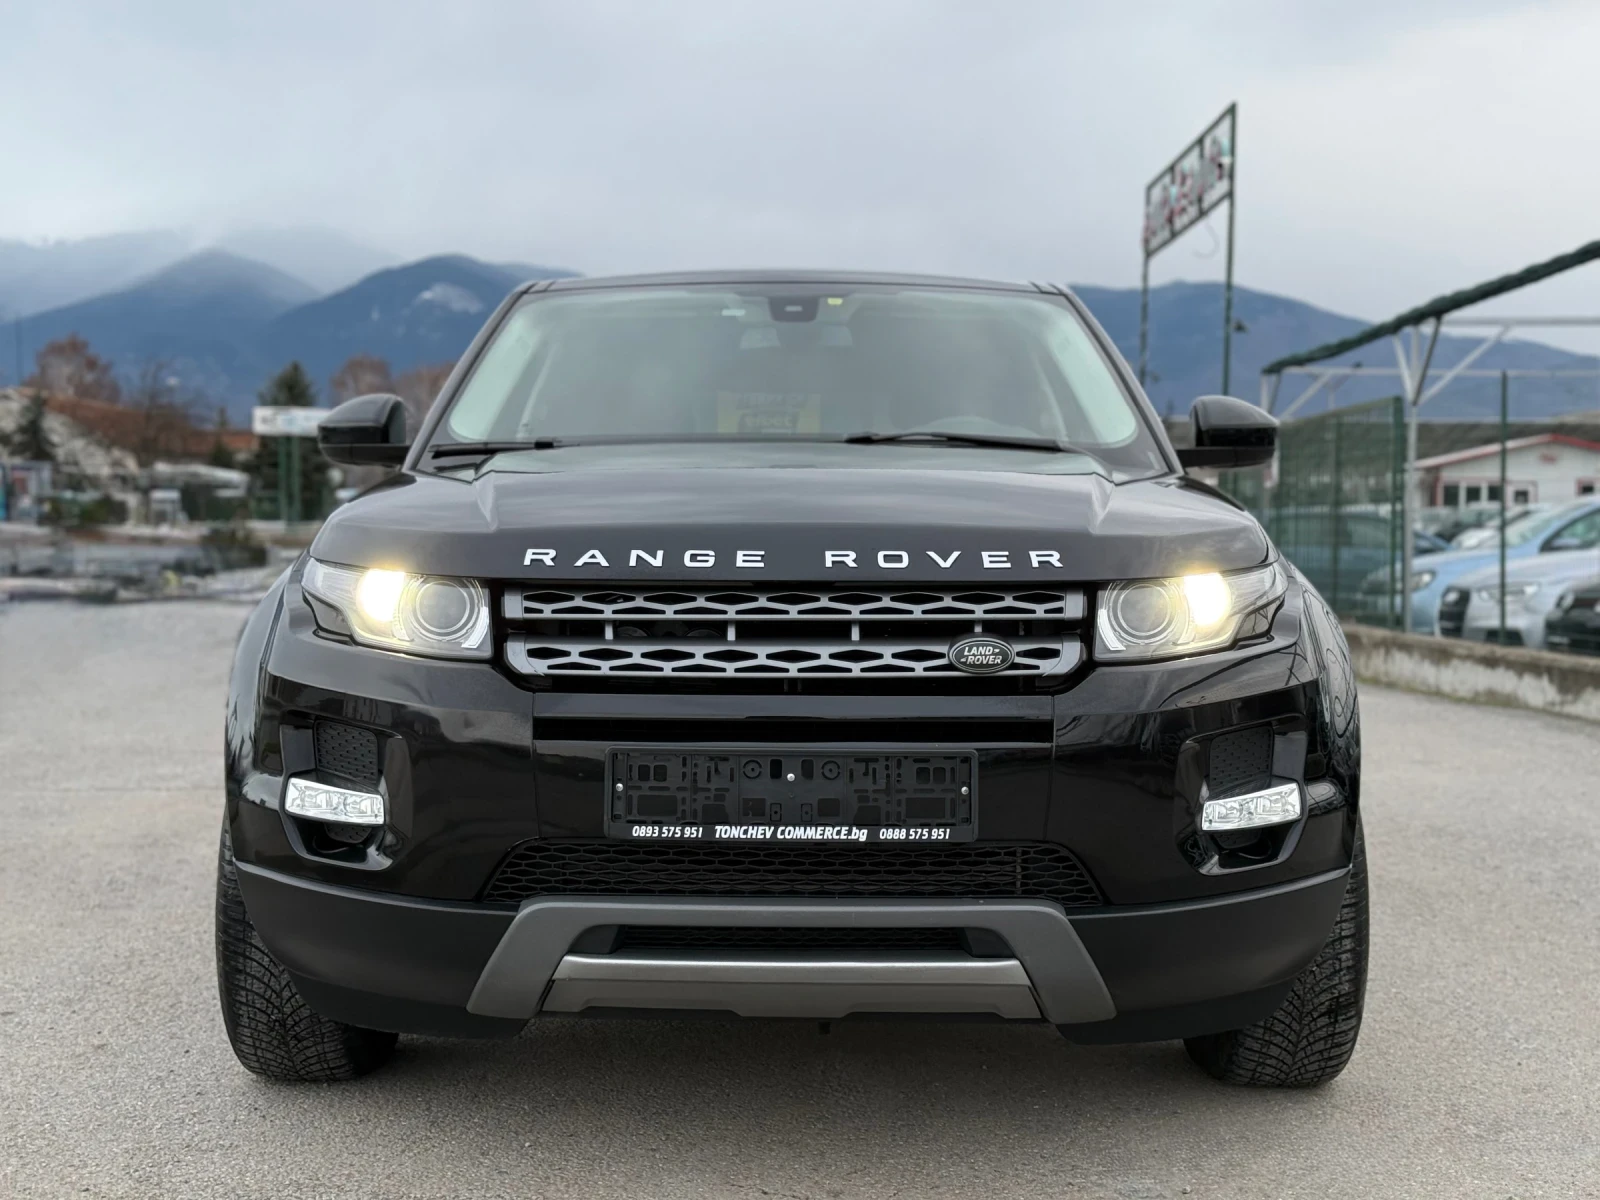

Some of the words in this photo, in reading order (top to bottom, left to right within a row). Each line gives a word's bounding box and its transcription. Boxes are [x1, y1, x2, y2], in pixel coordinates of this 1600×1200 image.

[523, 548, 766, 568] RANGE
[824, 549, 1064, 569] ROVER
[964, 646, 993, 655] LAND
[966, 655, 1003, 665] ROVER
[632, 825, 659, 837] 0893
[661, 826, 682, 838] 575
[683, 826, 703, 838] 951
[714, 825, 775, 839] TONCHEV
[776, 826, 868, 842] COMMERCE.bg
[879, 828, 907, 840] 0888
[908, 828, 929, 840] 575
[930, 828, 951, 840] 951
